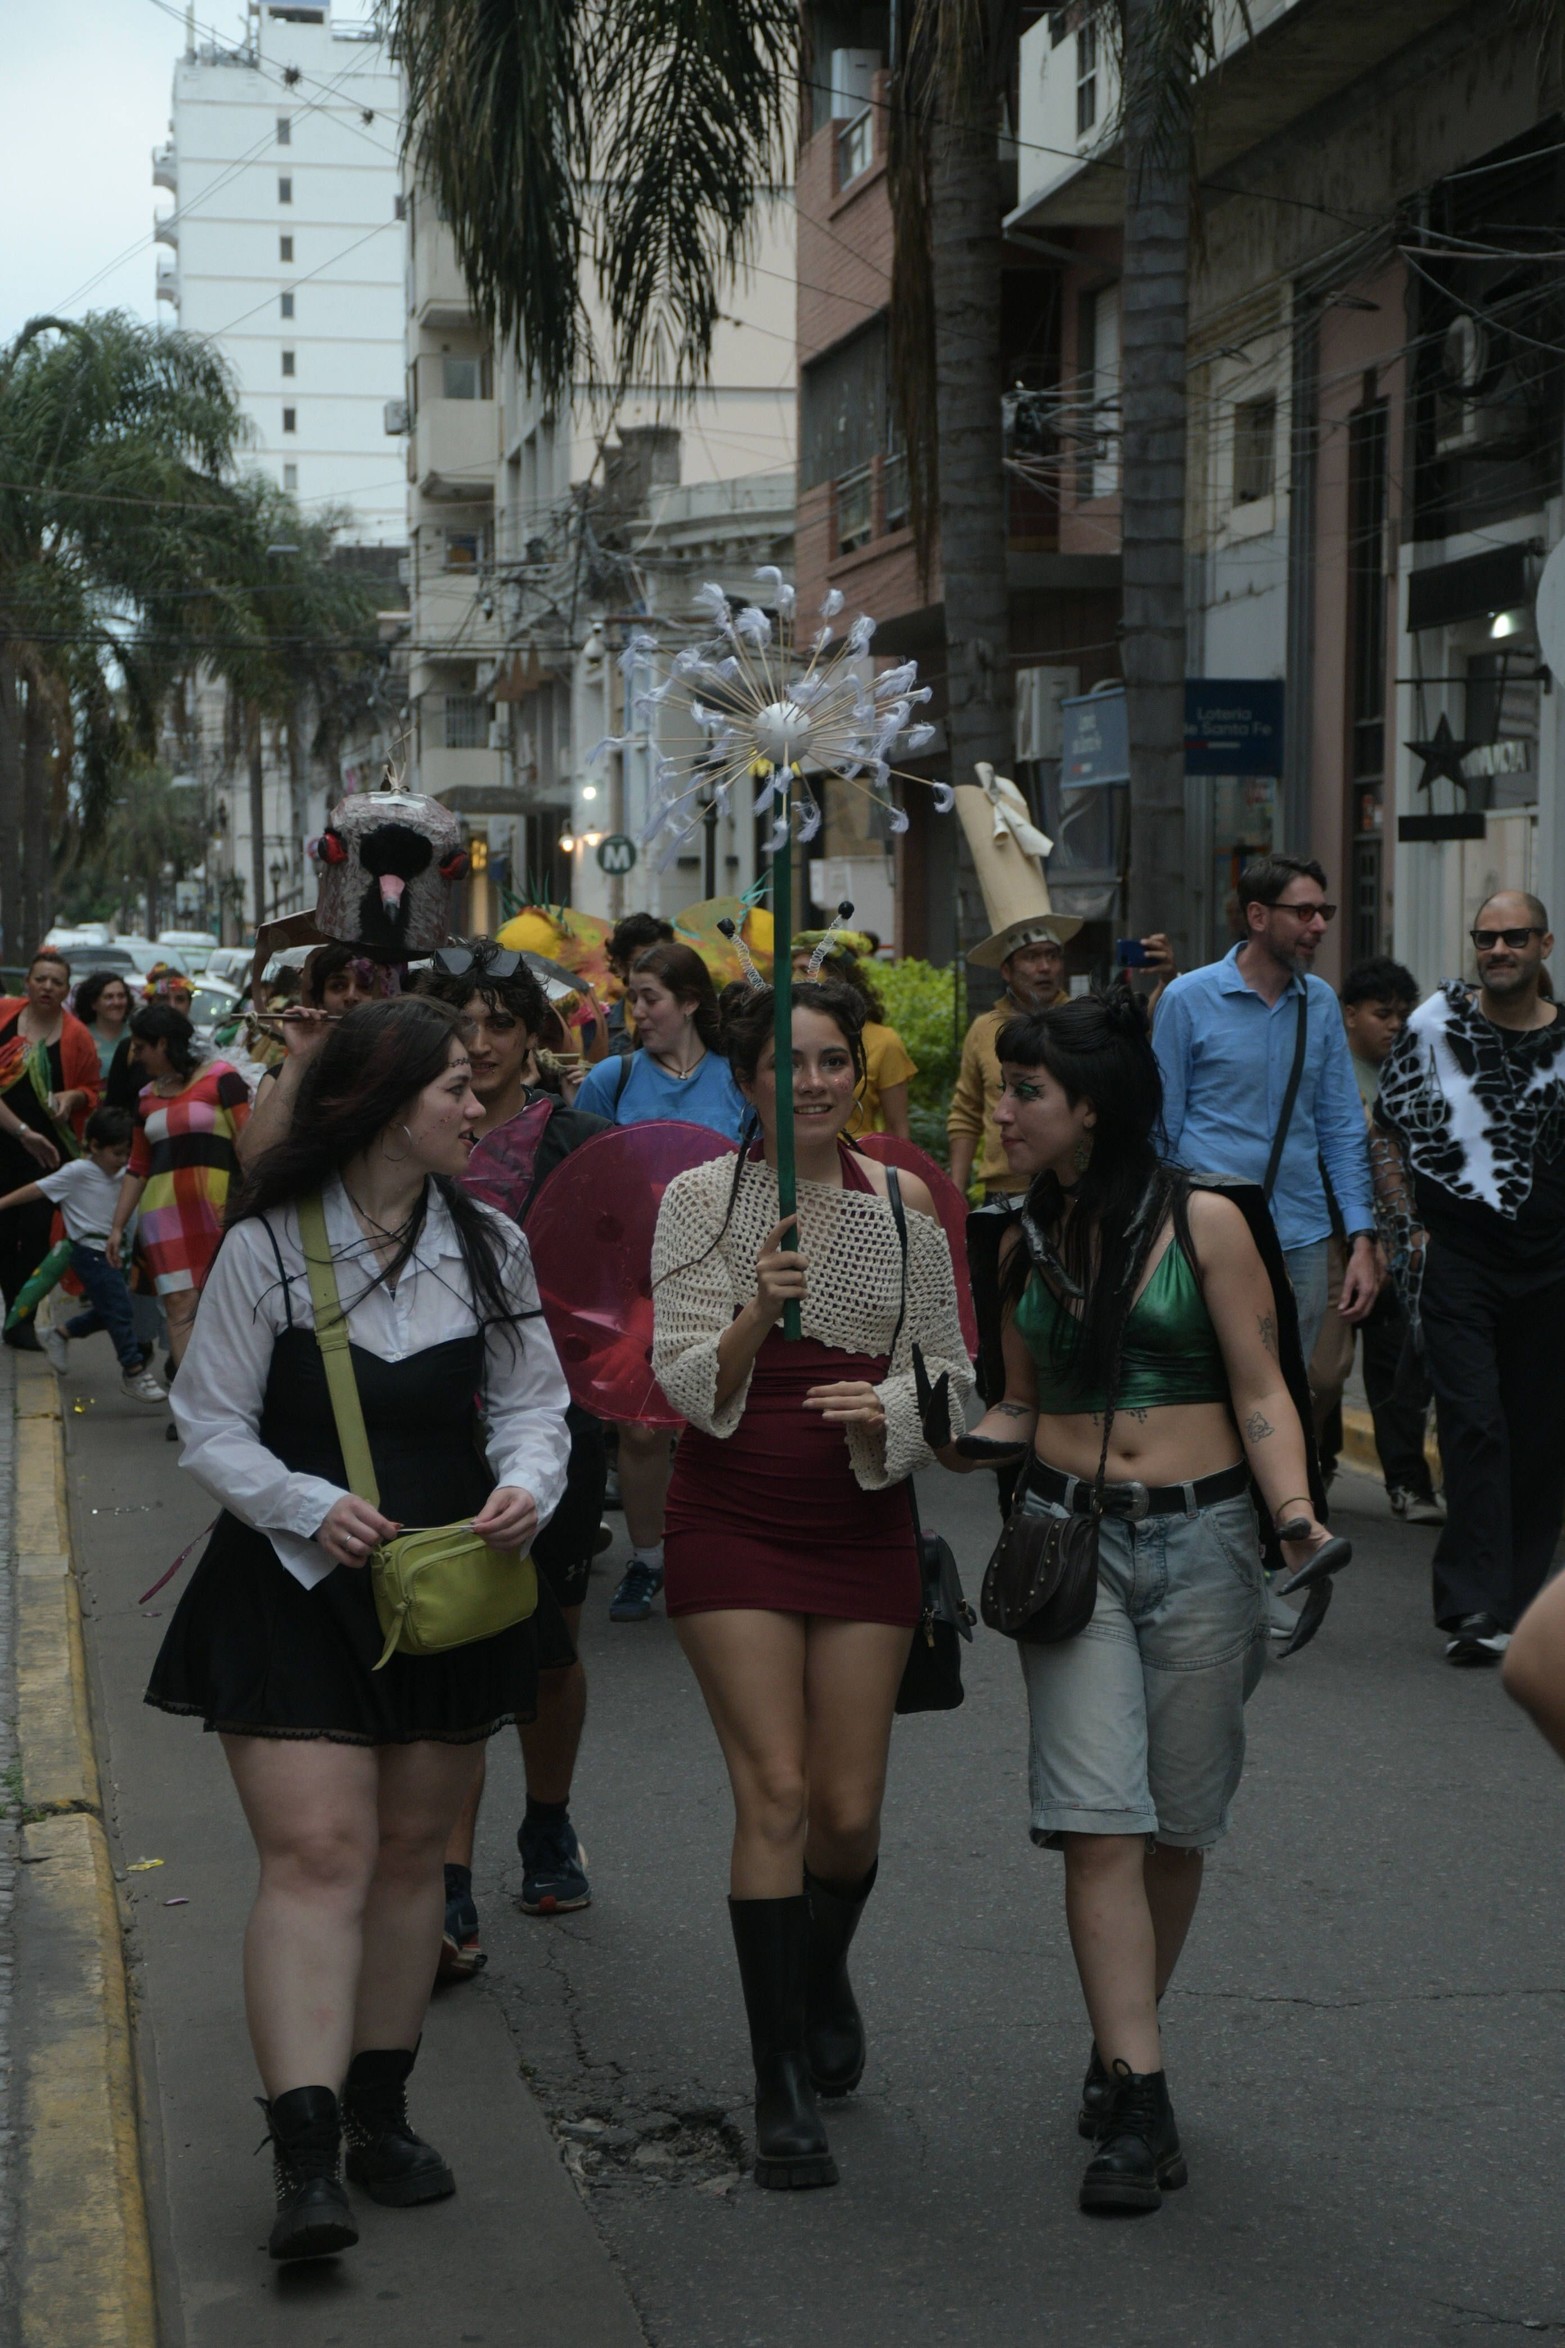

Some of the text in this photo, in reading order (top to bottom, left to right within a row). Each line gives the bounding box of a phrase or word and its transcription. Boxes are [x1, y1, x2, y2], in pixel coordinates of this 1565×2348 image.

[1201, 721, 1249, 736] Santa
[1253, 722, 1272, 736] Fe
[603, 844, 630, 870] M
